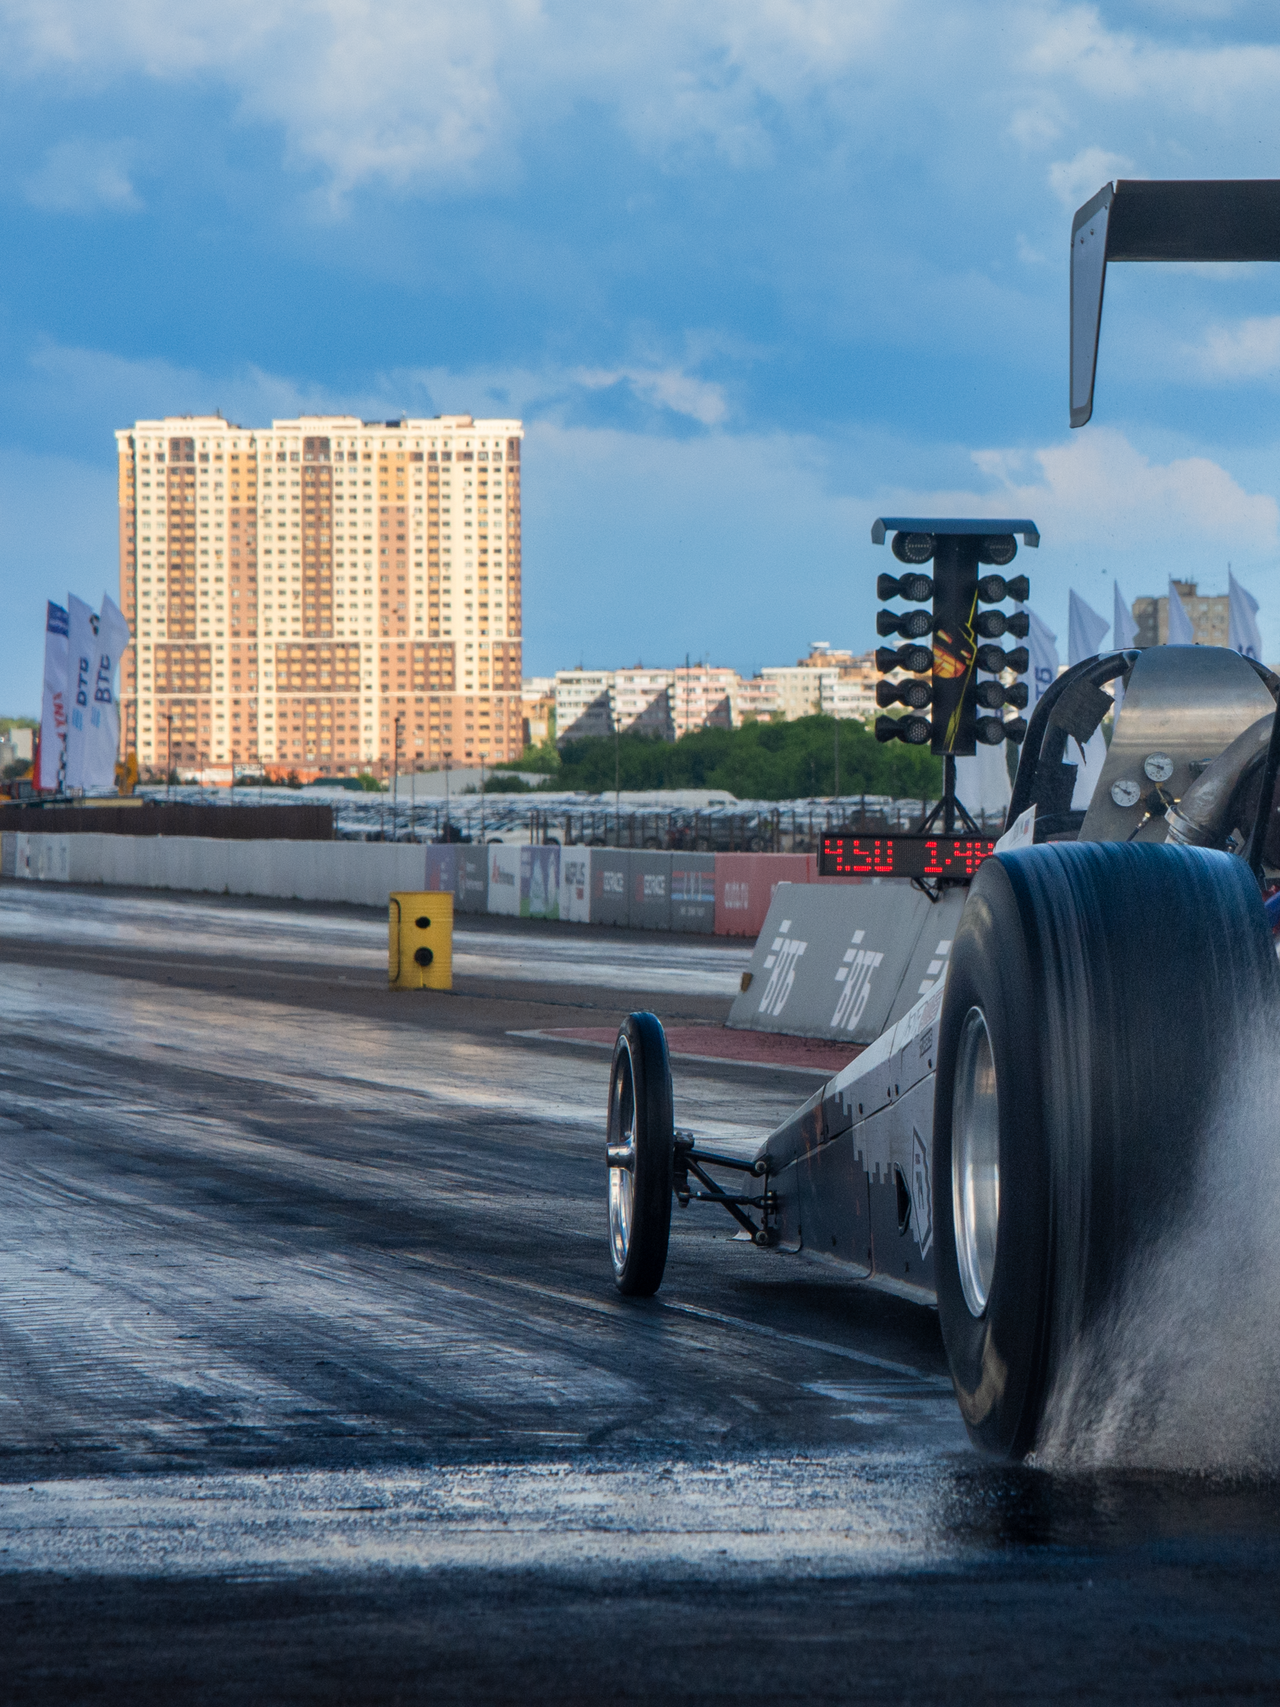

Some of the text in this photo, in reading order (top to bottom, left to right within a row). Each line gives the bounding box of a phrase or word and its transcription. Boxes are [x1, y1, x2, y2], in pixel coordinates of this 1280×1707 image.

[824, 840, 893, 871] 4.50
[759, 938, 808, 1016] ВТБ
[830, 949, 884, 1031] ВТБ
